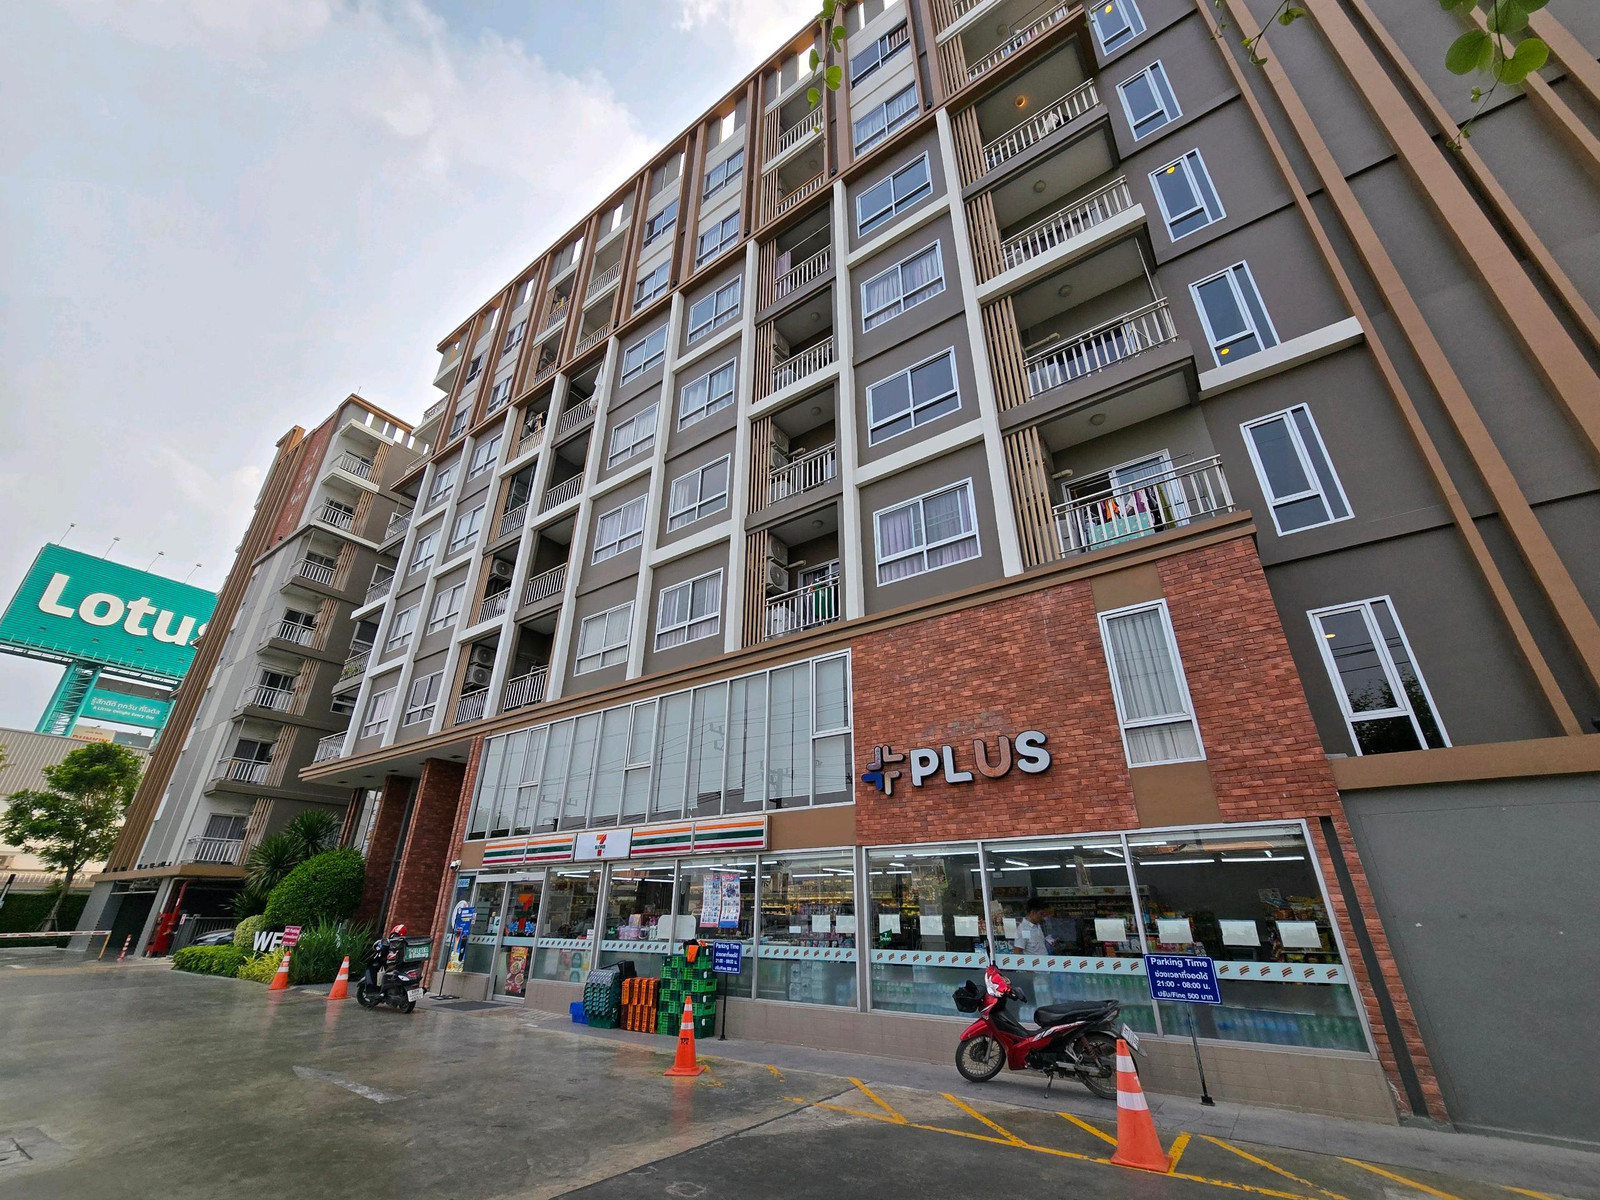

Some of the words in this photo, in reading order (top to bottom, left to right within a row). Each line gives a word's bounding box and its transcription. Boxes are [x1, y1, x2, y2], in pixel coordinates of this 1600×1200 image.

[909, 730, 1051, 787] PLUS
[1150, 957, 1183, 968] Parking
[1184, 959, 1208, 968] Time
[1187, 992, 1199, 1000] 500
